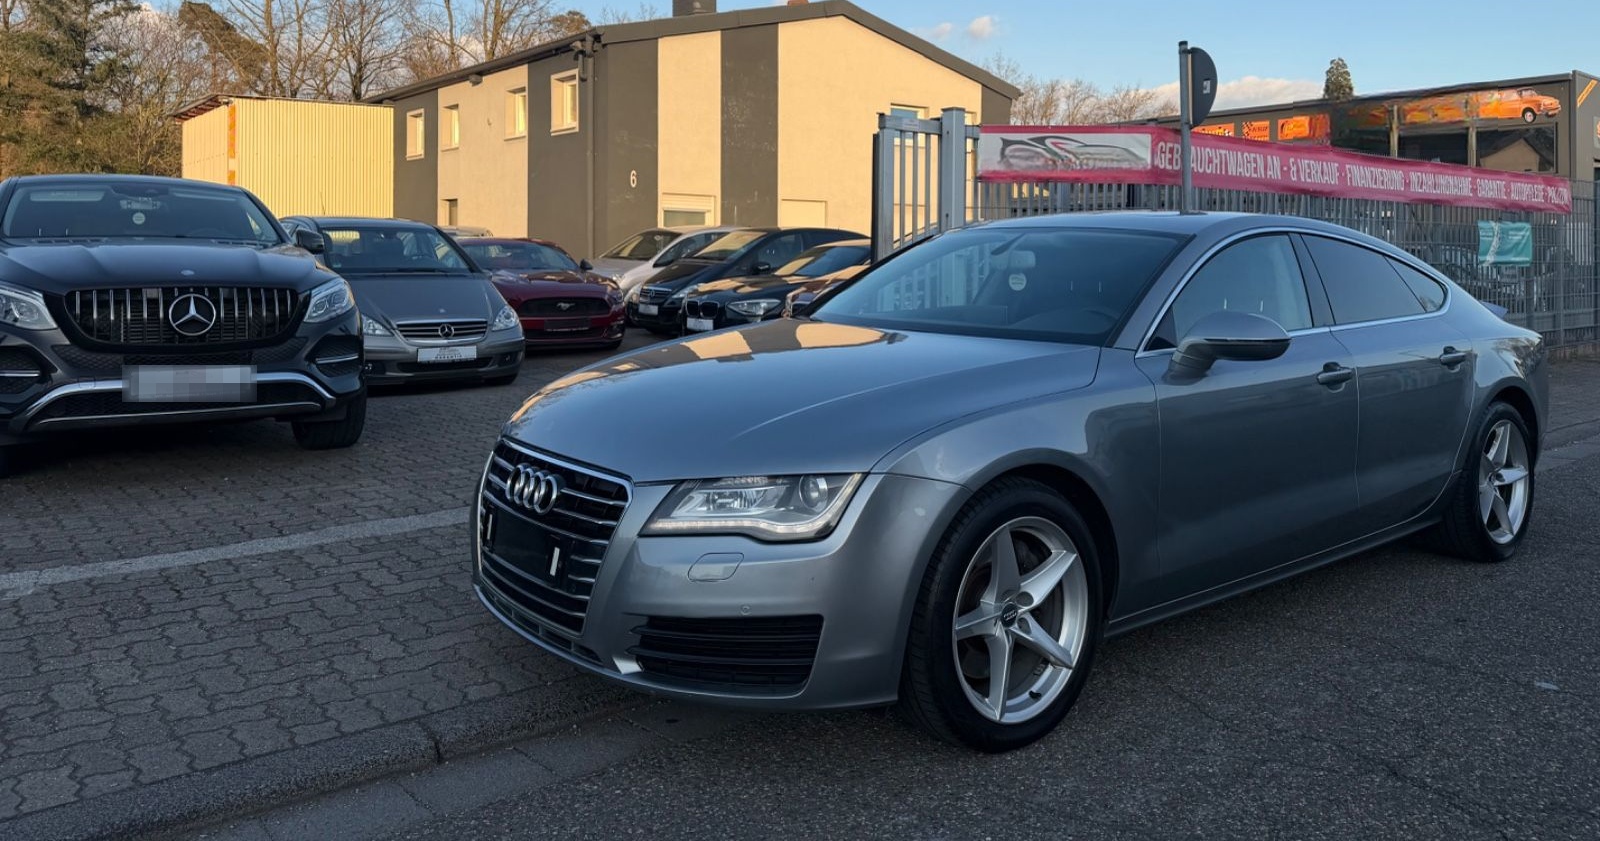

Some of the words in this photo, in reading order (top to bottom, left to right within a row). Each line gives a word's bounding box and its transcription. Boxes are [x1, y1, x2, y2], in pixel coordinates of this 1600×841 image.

[630, 169, 637, 188] 6
[1158, 141, 1265, 178] GEBAUCHTWAGEN
[1267, 154, 1281, 180] AN
[1289, 157, 1297, 181] &
[1298, 158, 1340, 185] VERKAUF
[1345, 163, 1405, 190] FINANZIERUNG
